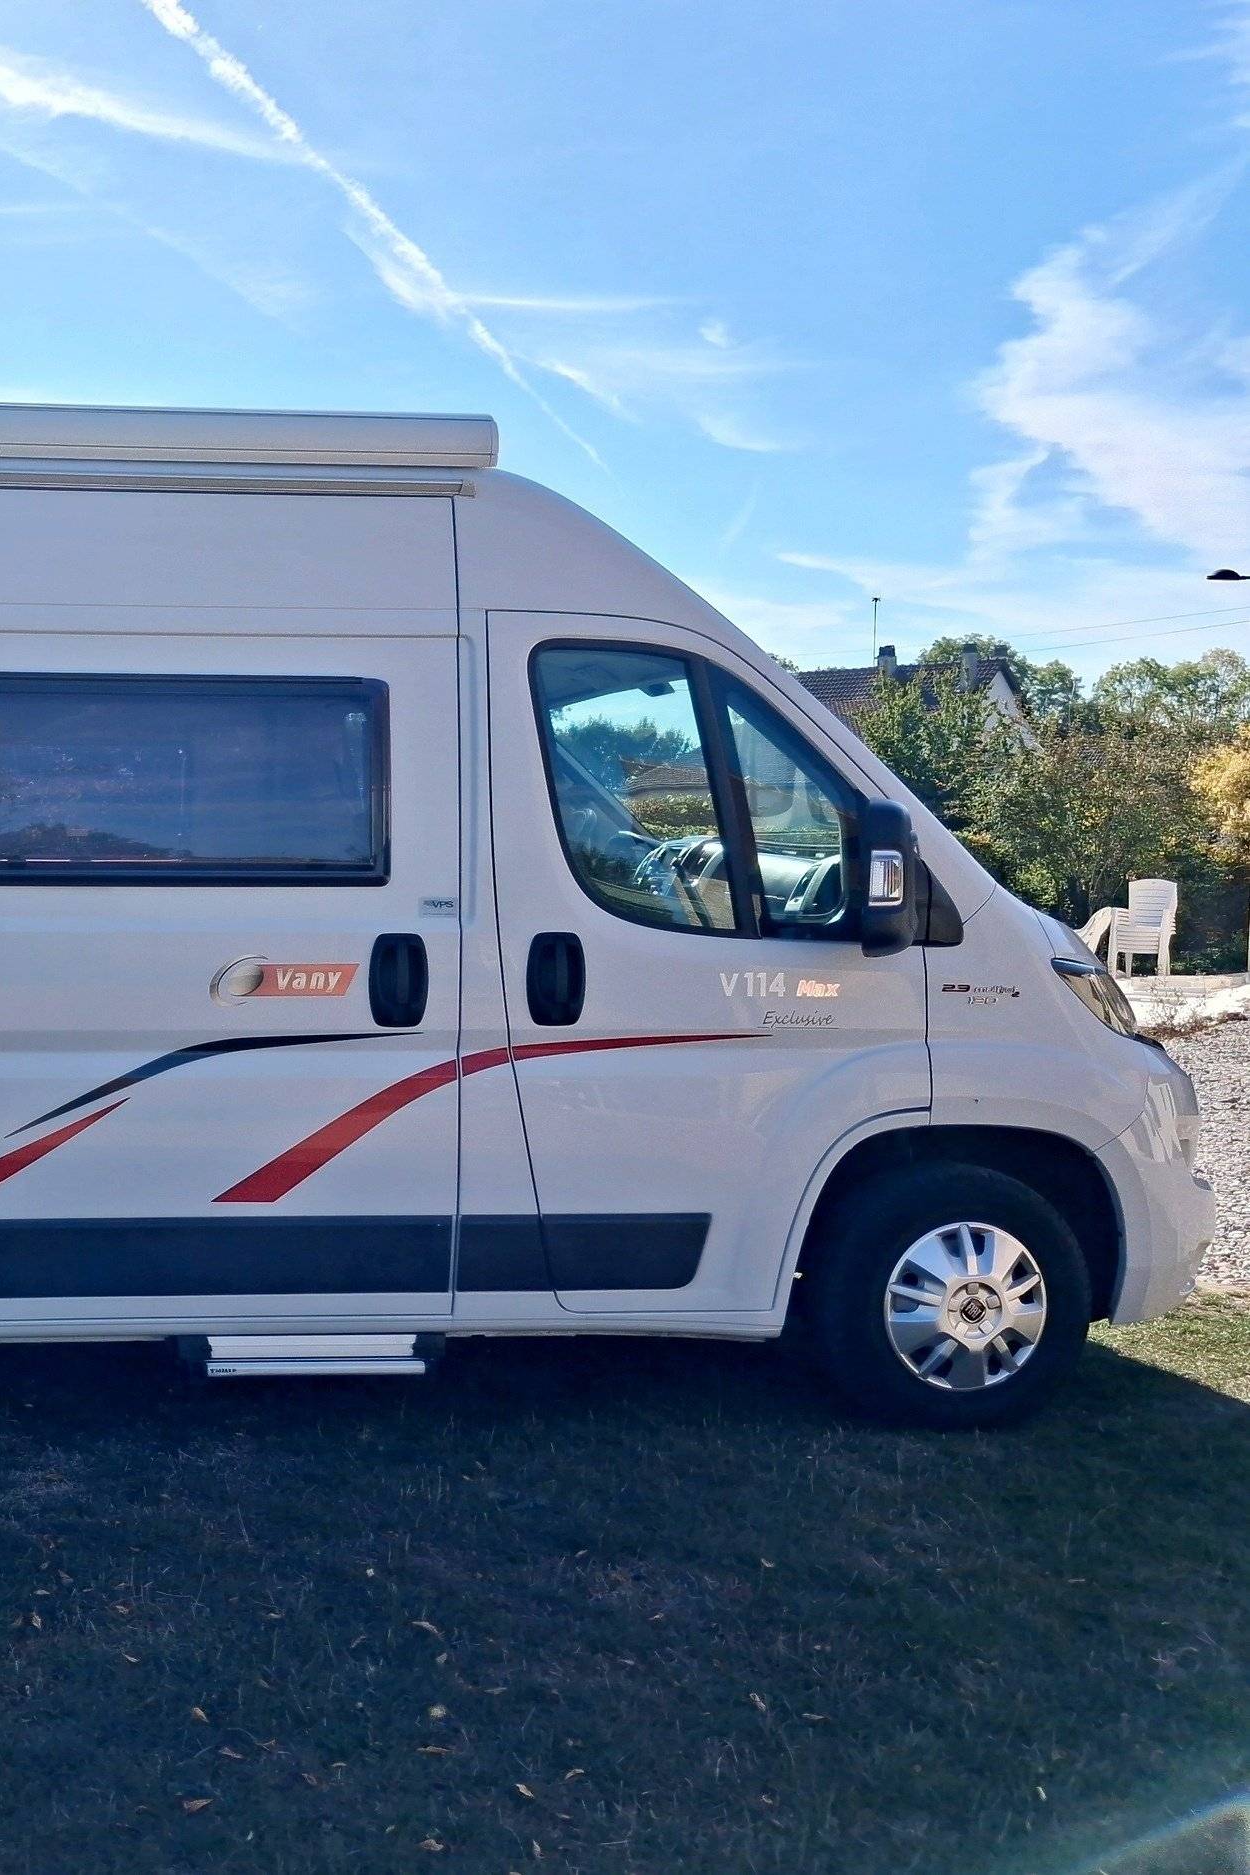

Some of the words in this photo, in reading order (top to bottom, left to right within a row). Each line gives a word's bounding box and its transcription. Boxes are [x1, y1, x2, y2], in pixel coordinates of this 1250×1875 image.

[276, 968, 342, 992] Vany
[744, 972, 786, 997] 114
[796, 980, 841, 998] Max
[763, 1010, 835, 1028] Exclusive
